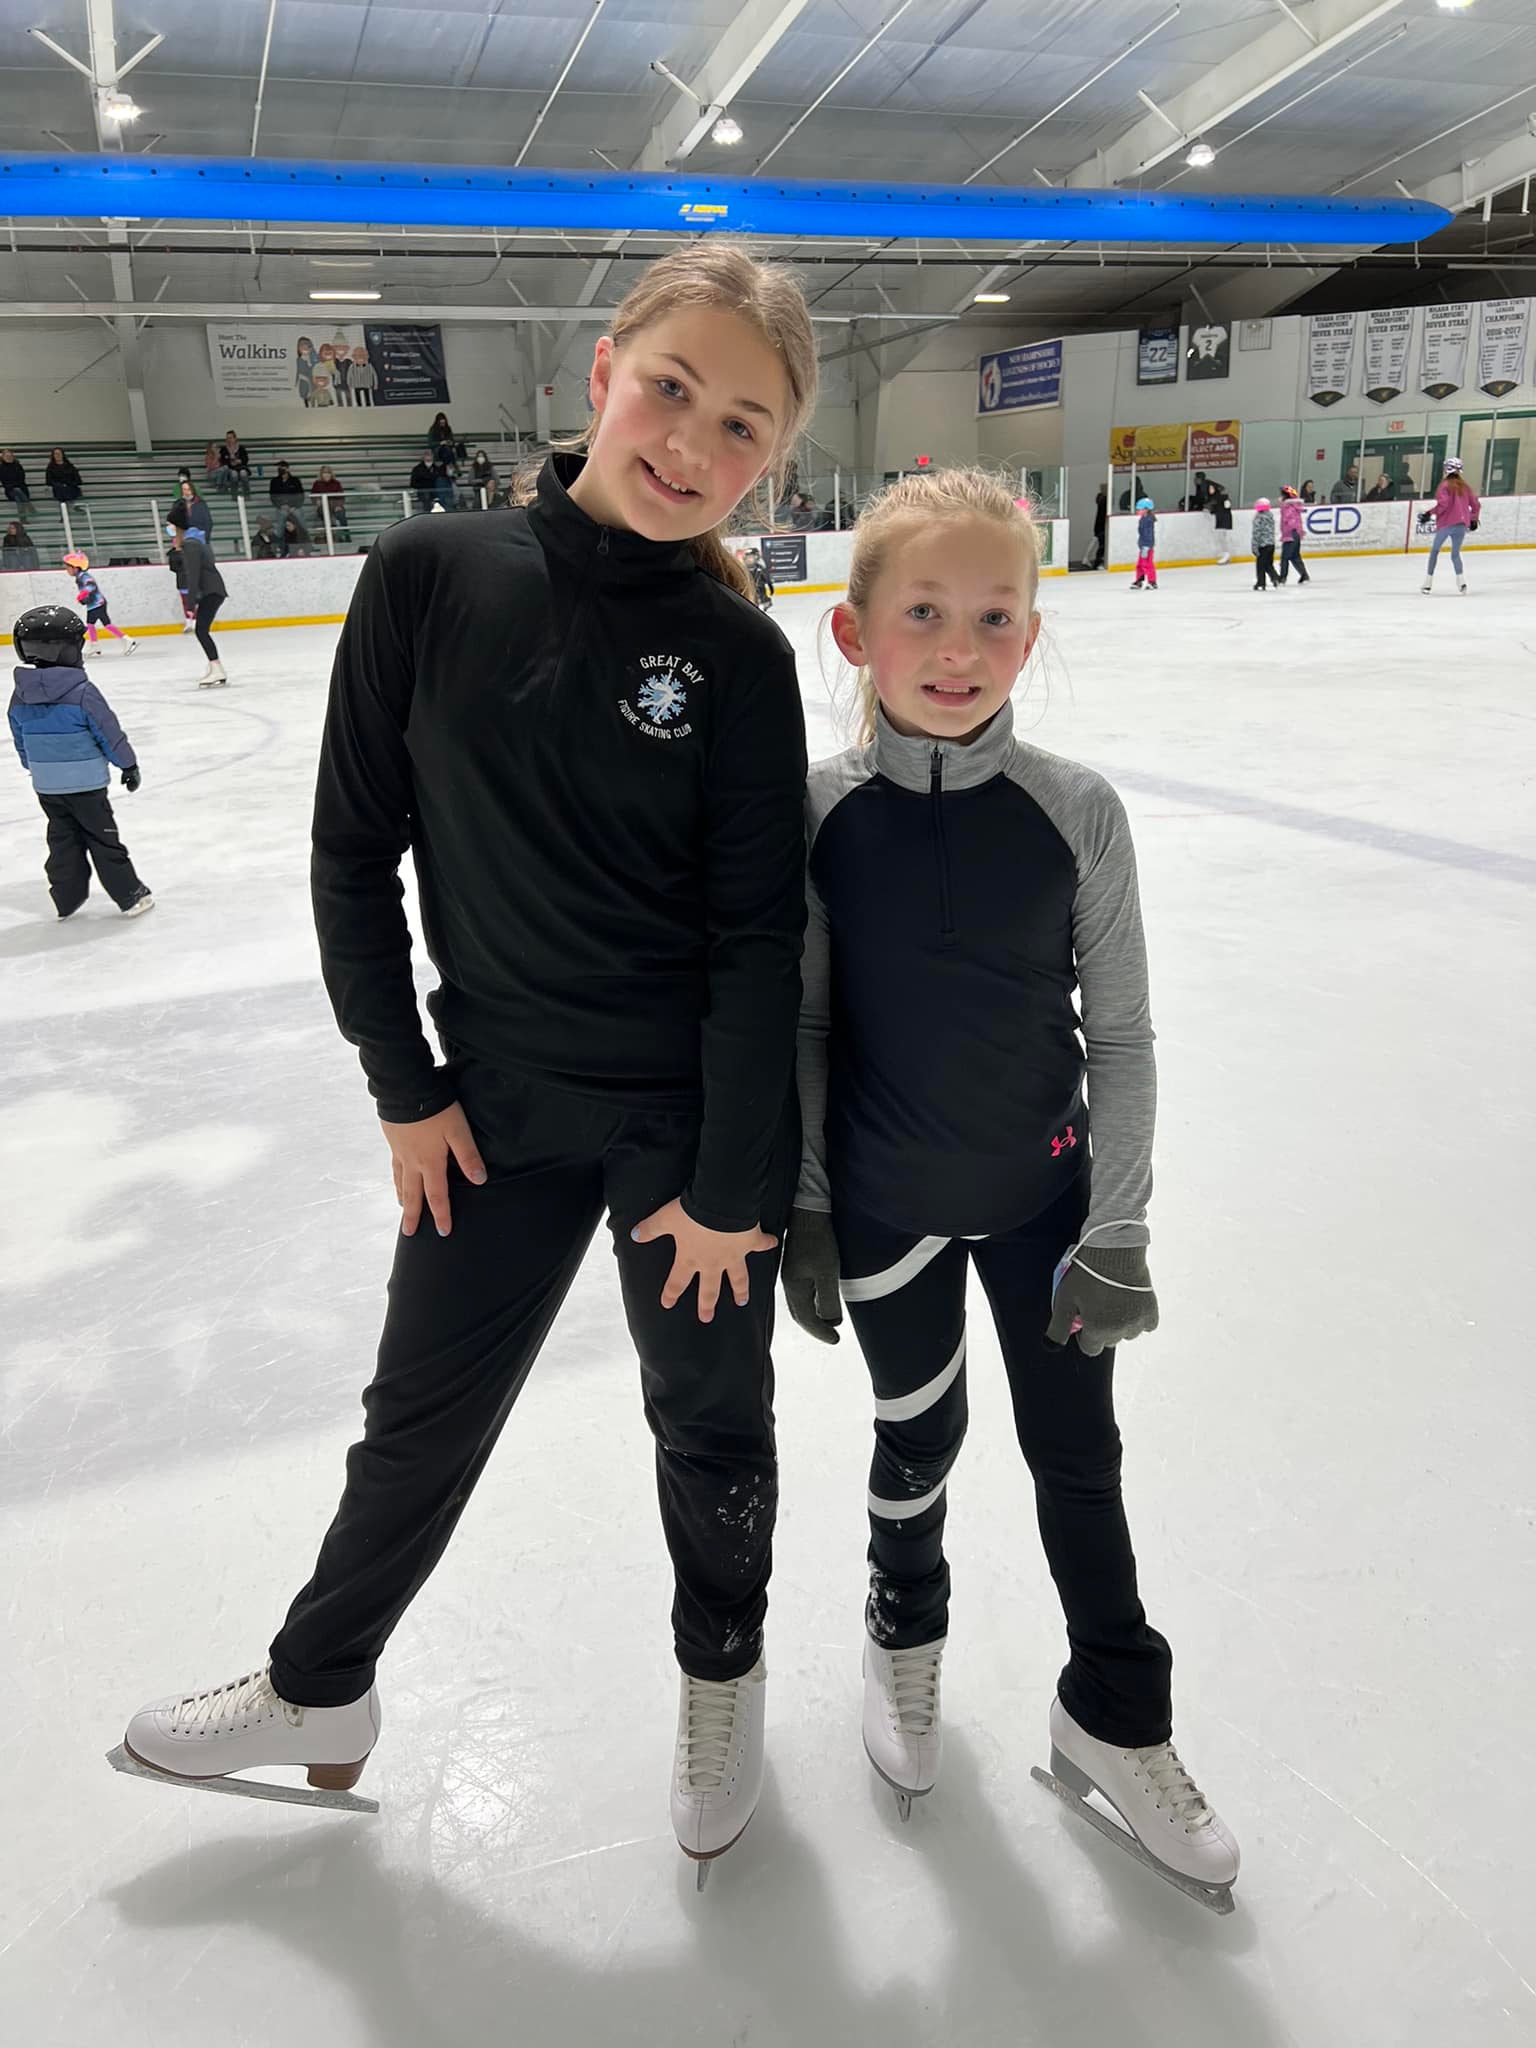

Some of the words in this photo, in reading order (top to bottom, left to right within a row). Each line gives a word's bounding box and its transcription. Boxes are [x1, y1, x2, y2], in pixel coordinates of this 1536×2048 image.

[1485, 313, 1525, 323] CHAMPIONS
[219, 344, 287, 359] Walkins
[1205, 339, 1212, 351] 2
[1149, 346, 1167, 362] 22
[1206, 436, 1228, 445] PRICE
[1303, 507, 1361, 534] ED
[640, 655, 682, 669] GREAT
[681, 662, 705, 683] BAY
[618, 699, 640, 725] FIGURE
[639, 721, 671, 739] SKATING
[673, 723, 692, 738] CLUB
